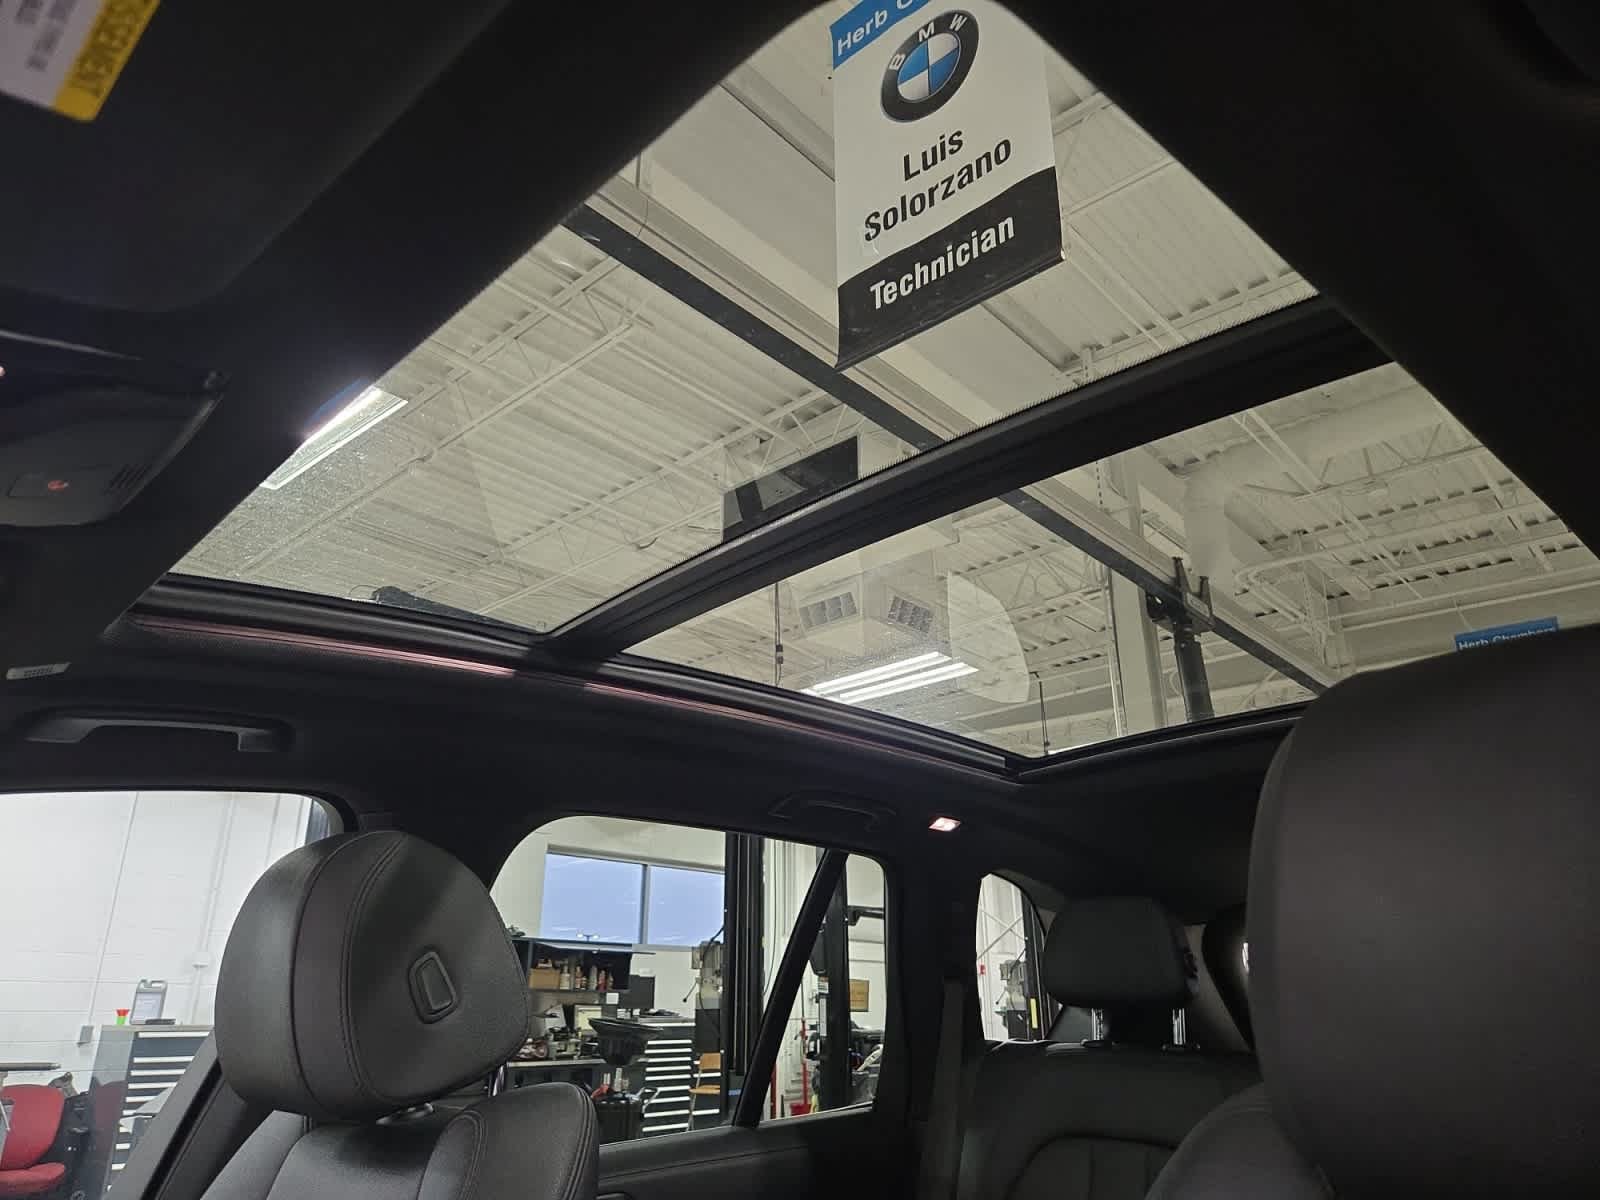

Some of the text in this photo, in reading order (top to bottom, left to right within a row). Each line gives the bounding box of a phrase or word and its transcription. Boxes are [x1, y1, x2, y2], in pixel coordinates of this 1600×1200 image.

[838, 9, 888, 57] Herb
[888, 13, 968, 70] BMW
[903, 130, 964, 181] Luis
[864, 139, 1012, 242] Solorzano
[870, 216, 1015, 310] Technician
